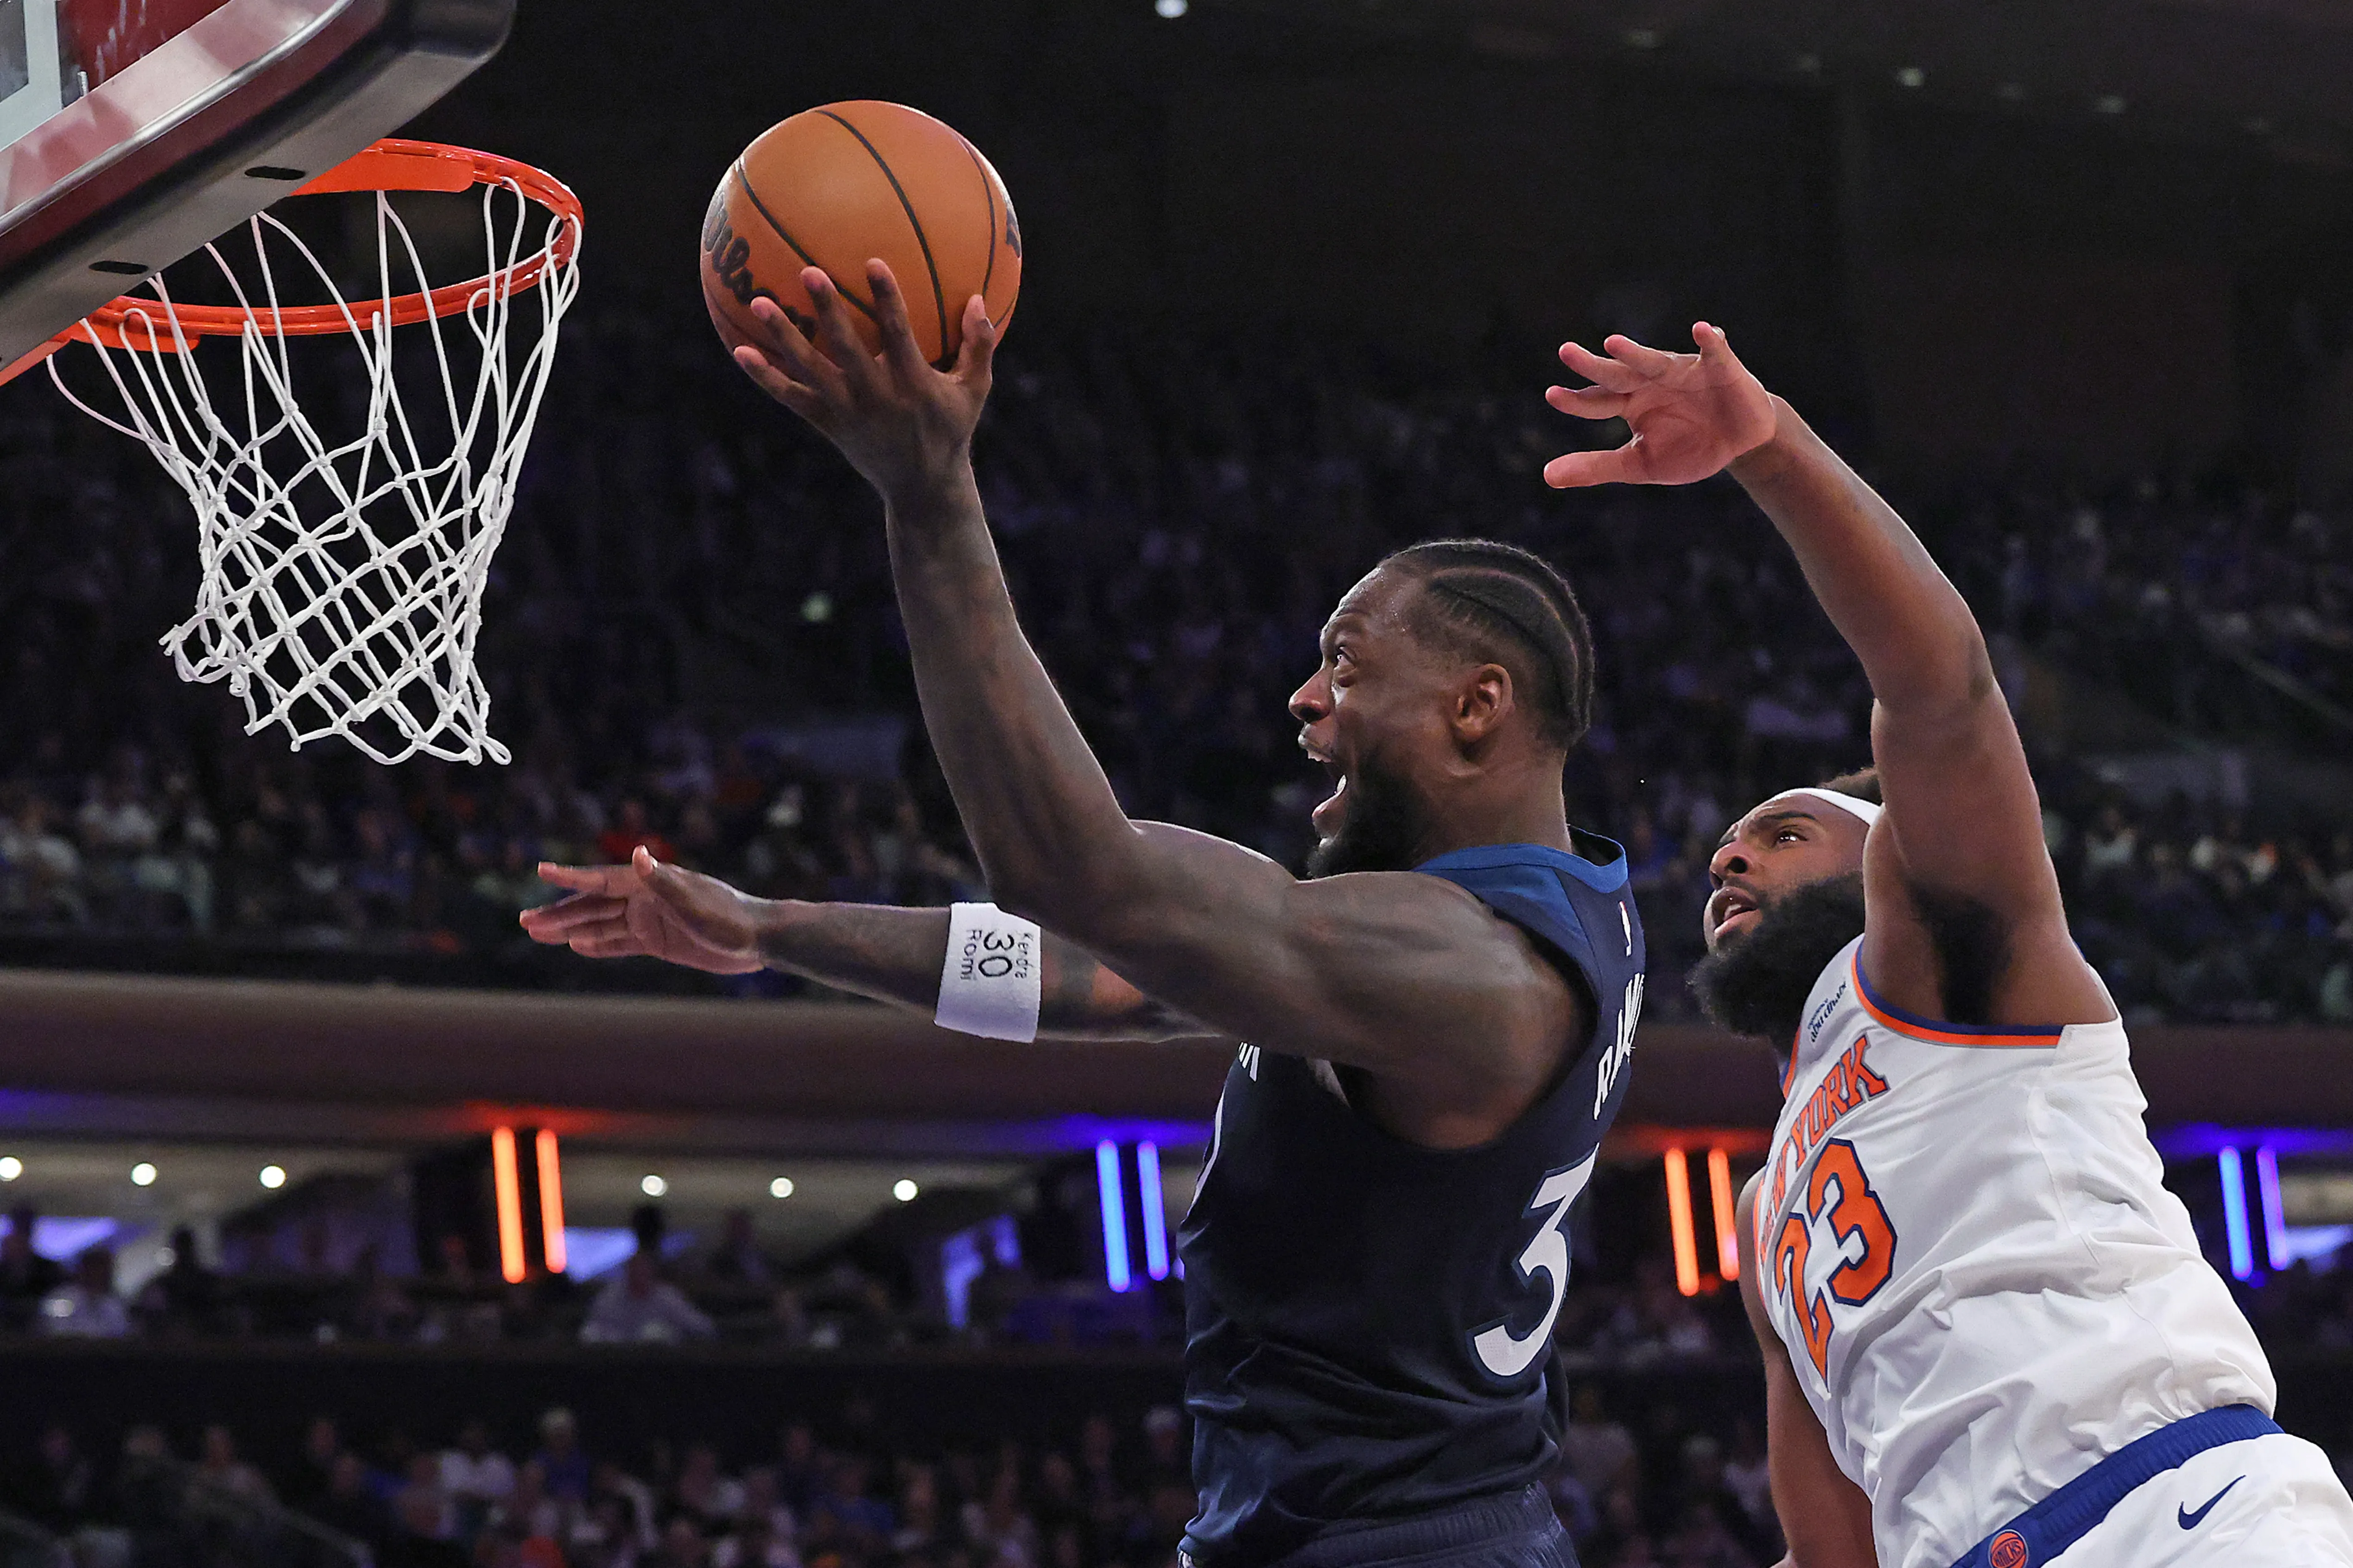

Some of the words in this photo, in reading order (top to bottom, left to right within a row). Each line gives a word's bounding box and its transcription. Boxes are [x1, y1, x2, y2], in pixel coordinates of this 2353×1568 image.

[978, 931, 1015, 977] 30
[1789, 1033, 1890, 1171] YORK
[1774, 1137, 1897, 1390] 23
